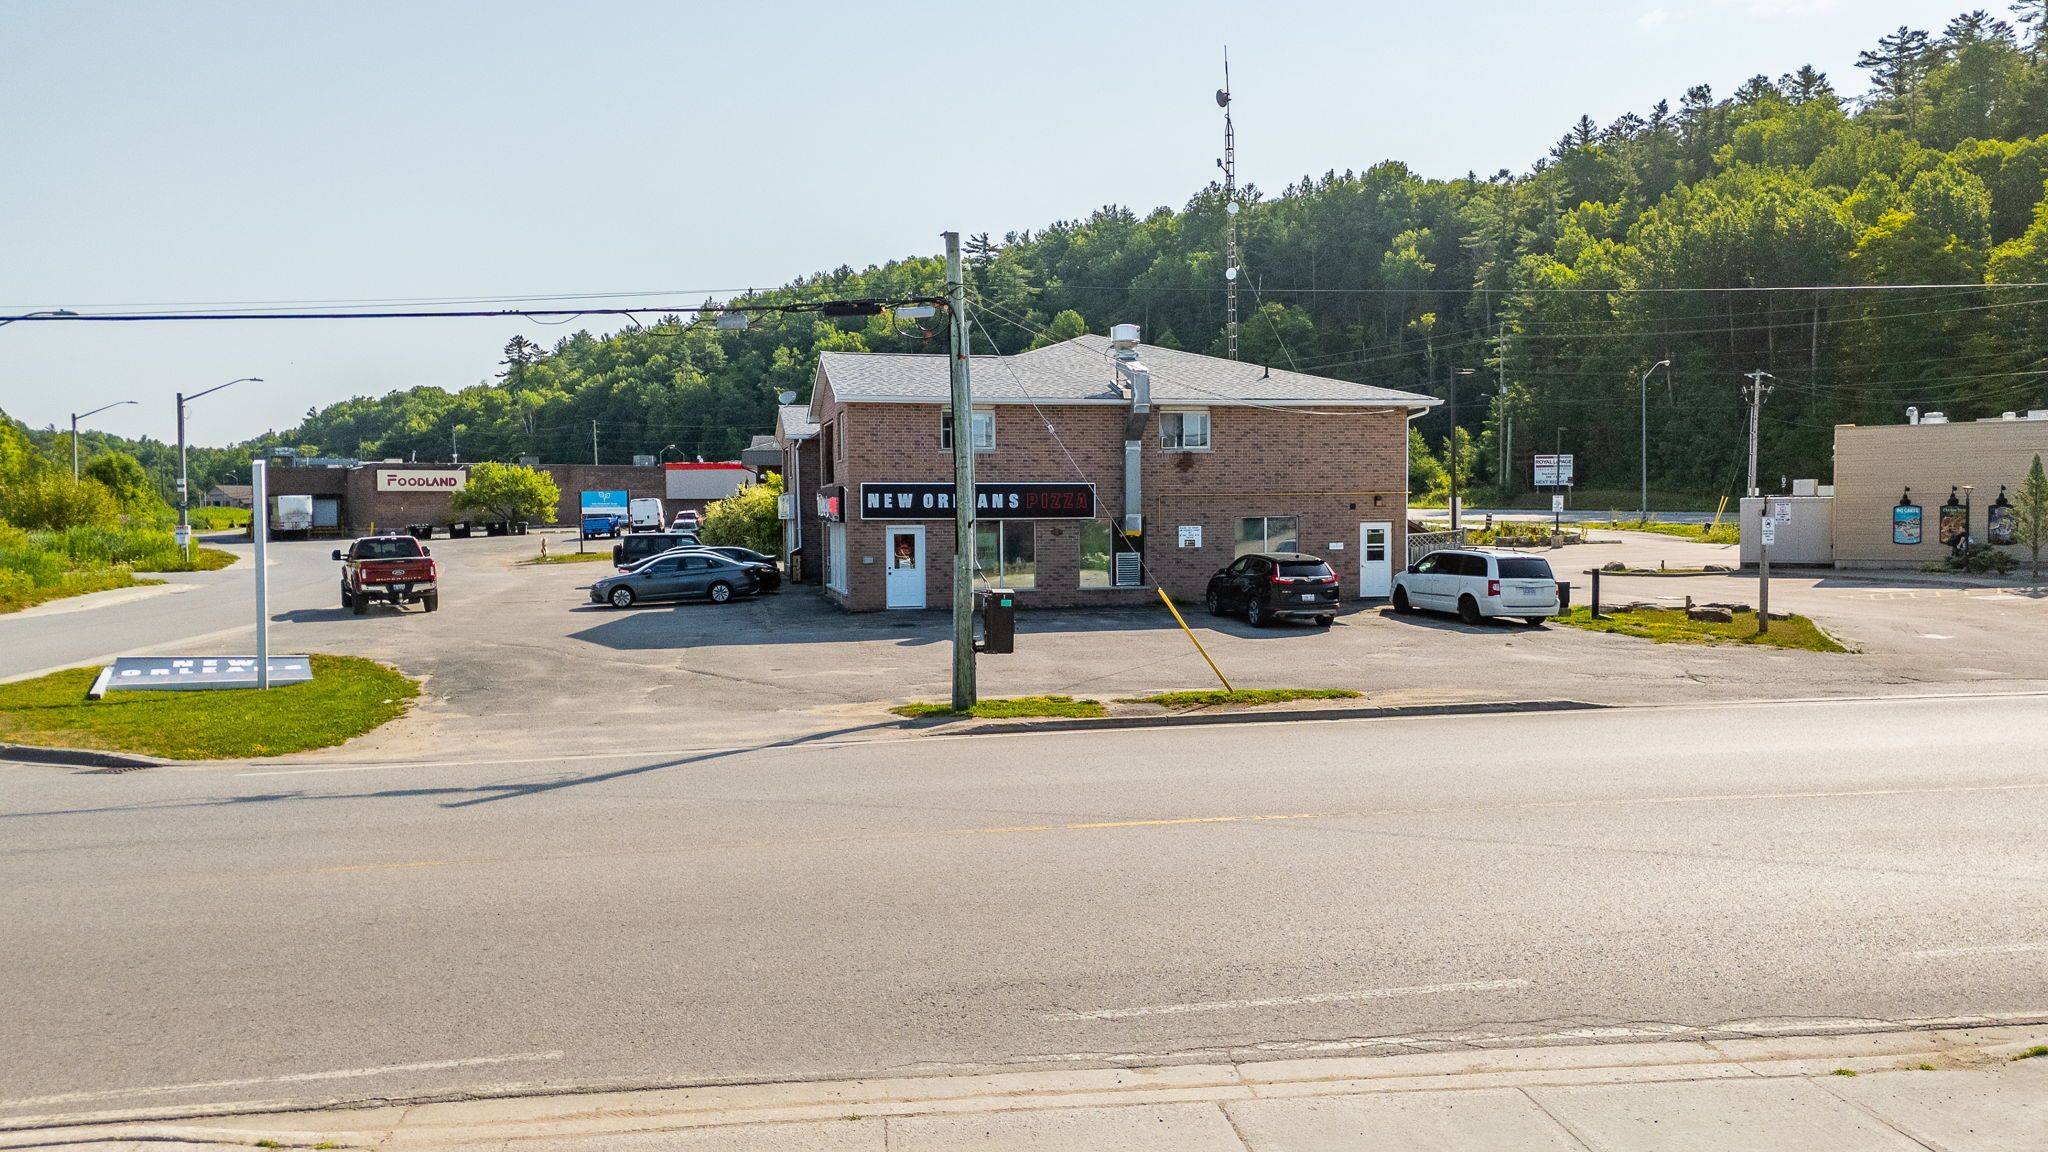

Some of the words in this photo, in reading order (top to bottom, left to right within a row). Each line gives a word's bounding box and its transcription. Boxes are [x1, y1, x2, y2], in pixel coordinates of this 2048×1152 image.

[387, 474, 457, 486] FOODLAND
[868, 493, 913, 509] NEW
[922, 493, 1019, 509] ORANS
[1026, 493, 1087, 508] PIZZA
[172, 659, 255, 668] NEW
